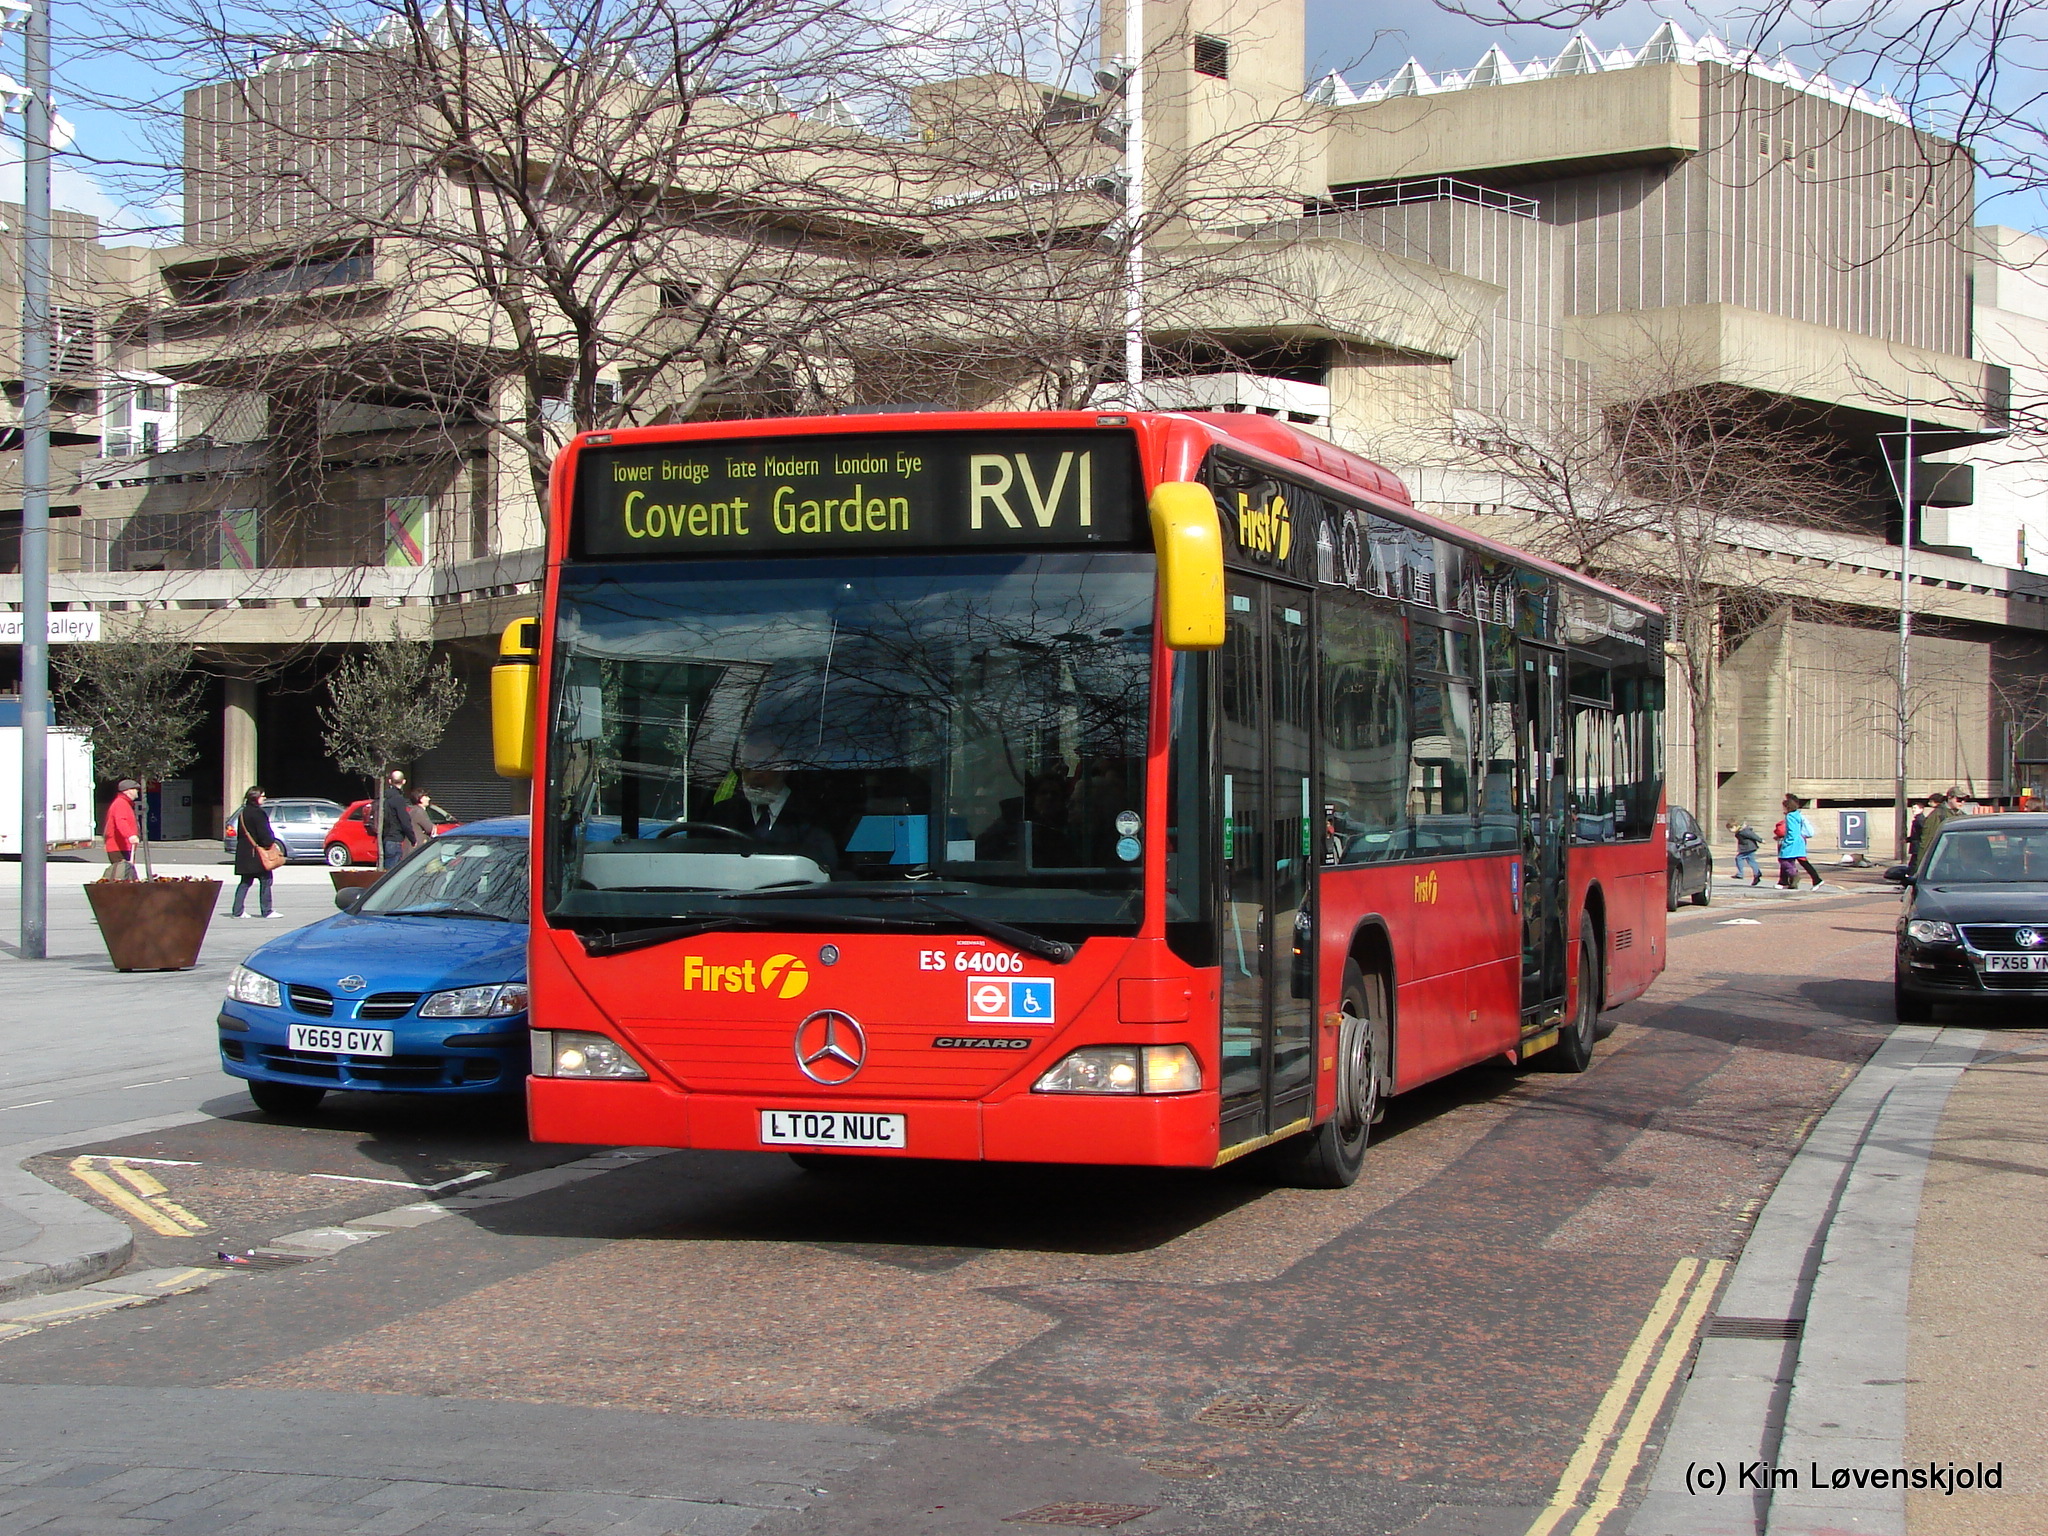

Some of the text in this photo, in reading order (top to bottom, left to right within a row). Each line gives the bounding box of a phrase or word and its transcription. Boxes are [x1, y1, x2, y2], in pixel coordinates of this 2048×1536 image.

[612, 451, 922, 485] Tower Bridge Tate Modern London Eye
[970, 450, 1092, 530] RV1
[624, 483, 909, 539] Covent Garden
[1238, 492, 1272, 553] First
[46, 619, 94, 638] allery
[1846, 815, 1861, 836] P
[1414, 875, 1429, 904] First
[684, 955, 756, 993] First
[919, 950, 1024, 973] ES 64006
[1992, 957, 2029, 970] FX58
[297, 1028, 383, 1052] Y669 GVX
[936, 1037, 1028, 1049] CITARO
[771, 1113, 891, 1141] LT02 NUC
